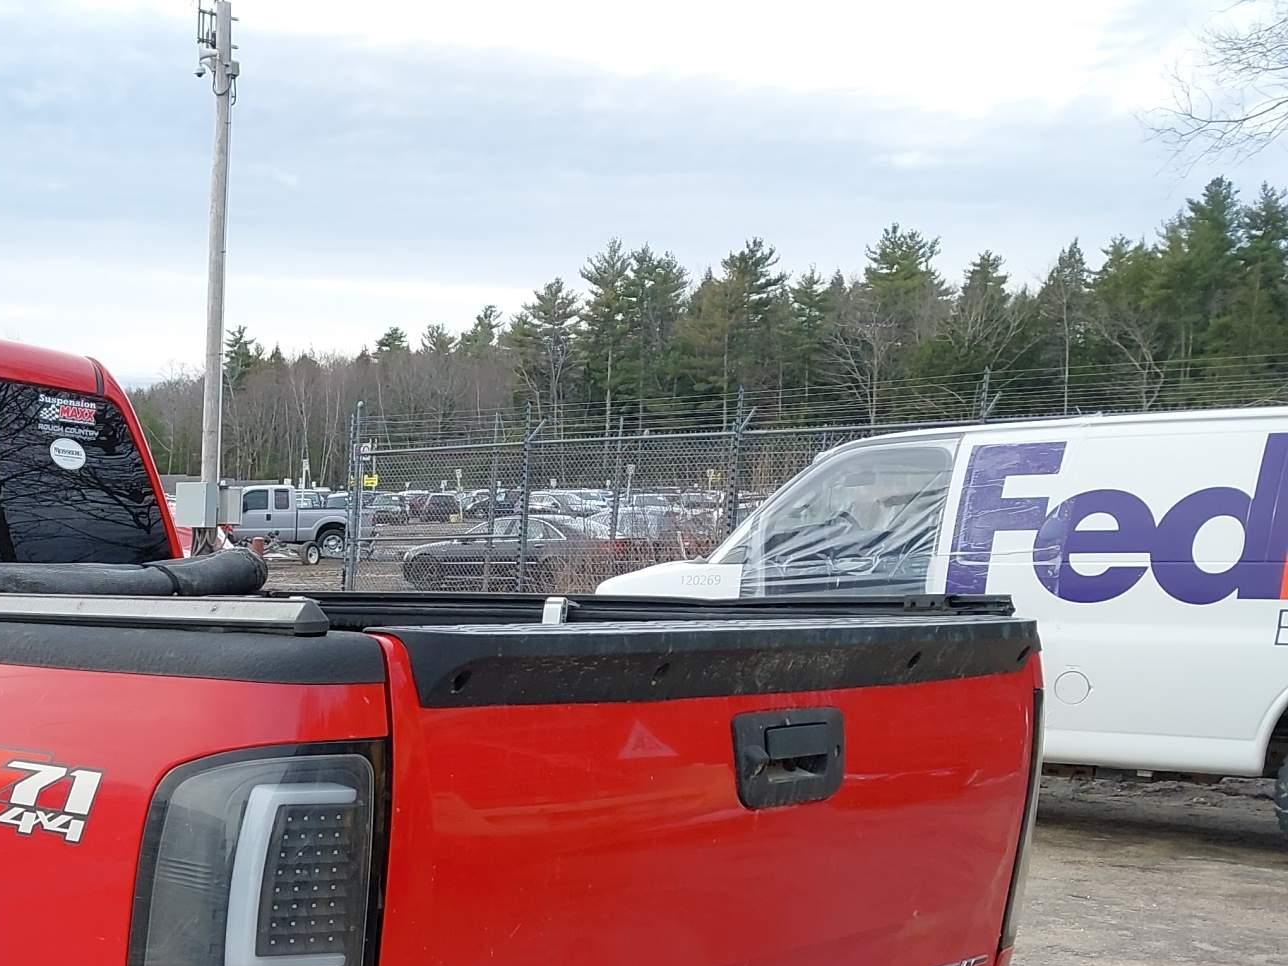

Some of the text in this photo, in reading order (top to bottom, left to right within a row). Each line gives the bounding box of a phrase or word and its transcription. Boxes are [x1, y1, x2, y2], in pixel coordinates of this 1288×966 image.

[39, 393, 97, 409] Suspension
[59, 405, 97, 422] MAXX
[38, 423, 64, 433] ROUGH
[64, 427, 100, 438] COUNTRY
[945, 432, 1288, 605] Fed
[680, 574, 721, 586] 120269
